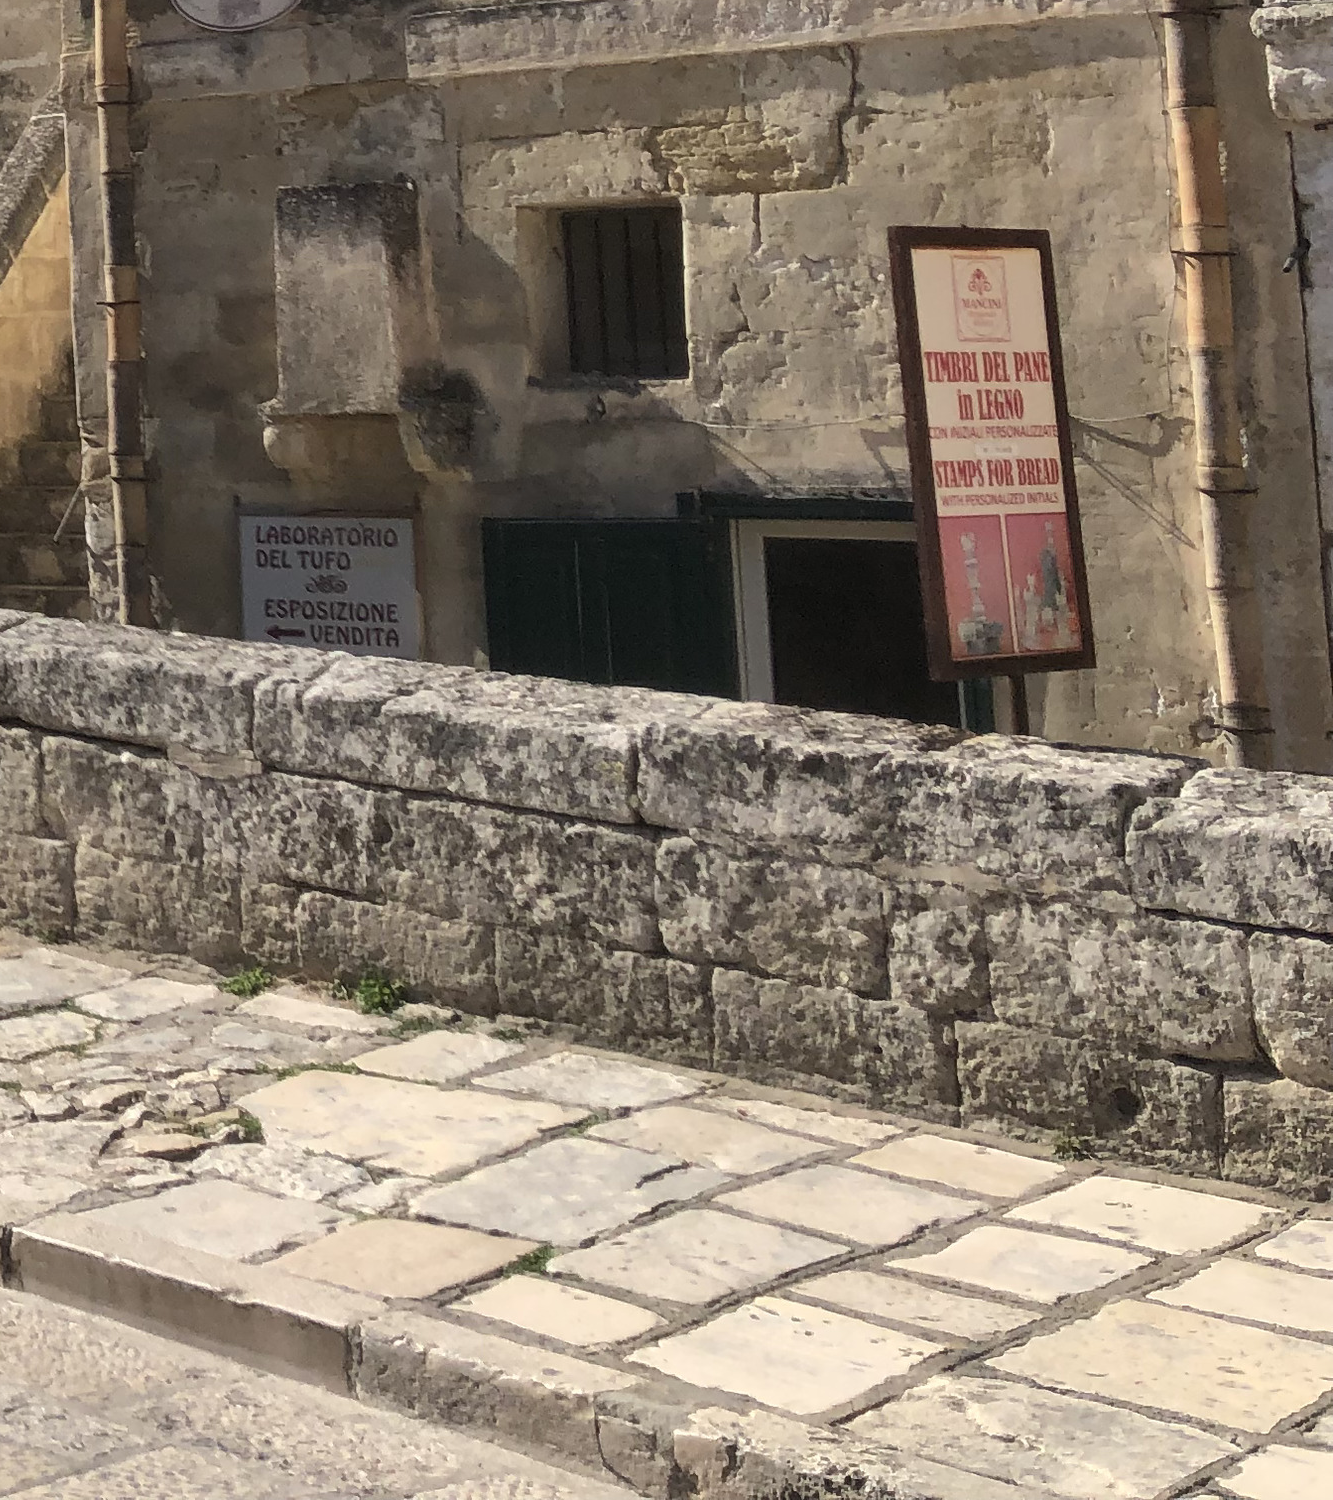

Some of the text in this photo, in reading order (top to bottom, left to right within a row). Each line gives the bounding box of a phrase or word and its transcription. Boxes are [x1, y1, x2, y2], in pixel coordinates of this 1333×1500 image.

[961, 297, 1002, 310] MANCINI
[923, 351, 1051, 383] TIMBRI DEL PANE
[957, 388, 1025, 421] in LEGNO
[985, 424, 1058, 439] PERSONALIZZATE
[934, 457, 1060, 489] STAMPS FOR BREAD
[255, 524, 399, 548] LABORATORIO
[255, 548, 352, 571] DEL TUFO
[264, 598, 400, 624] ESPOSIZIONE
[309, 623, 400, 648] VENDITA
